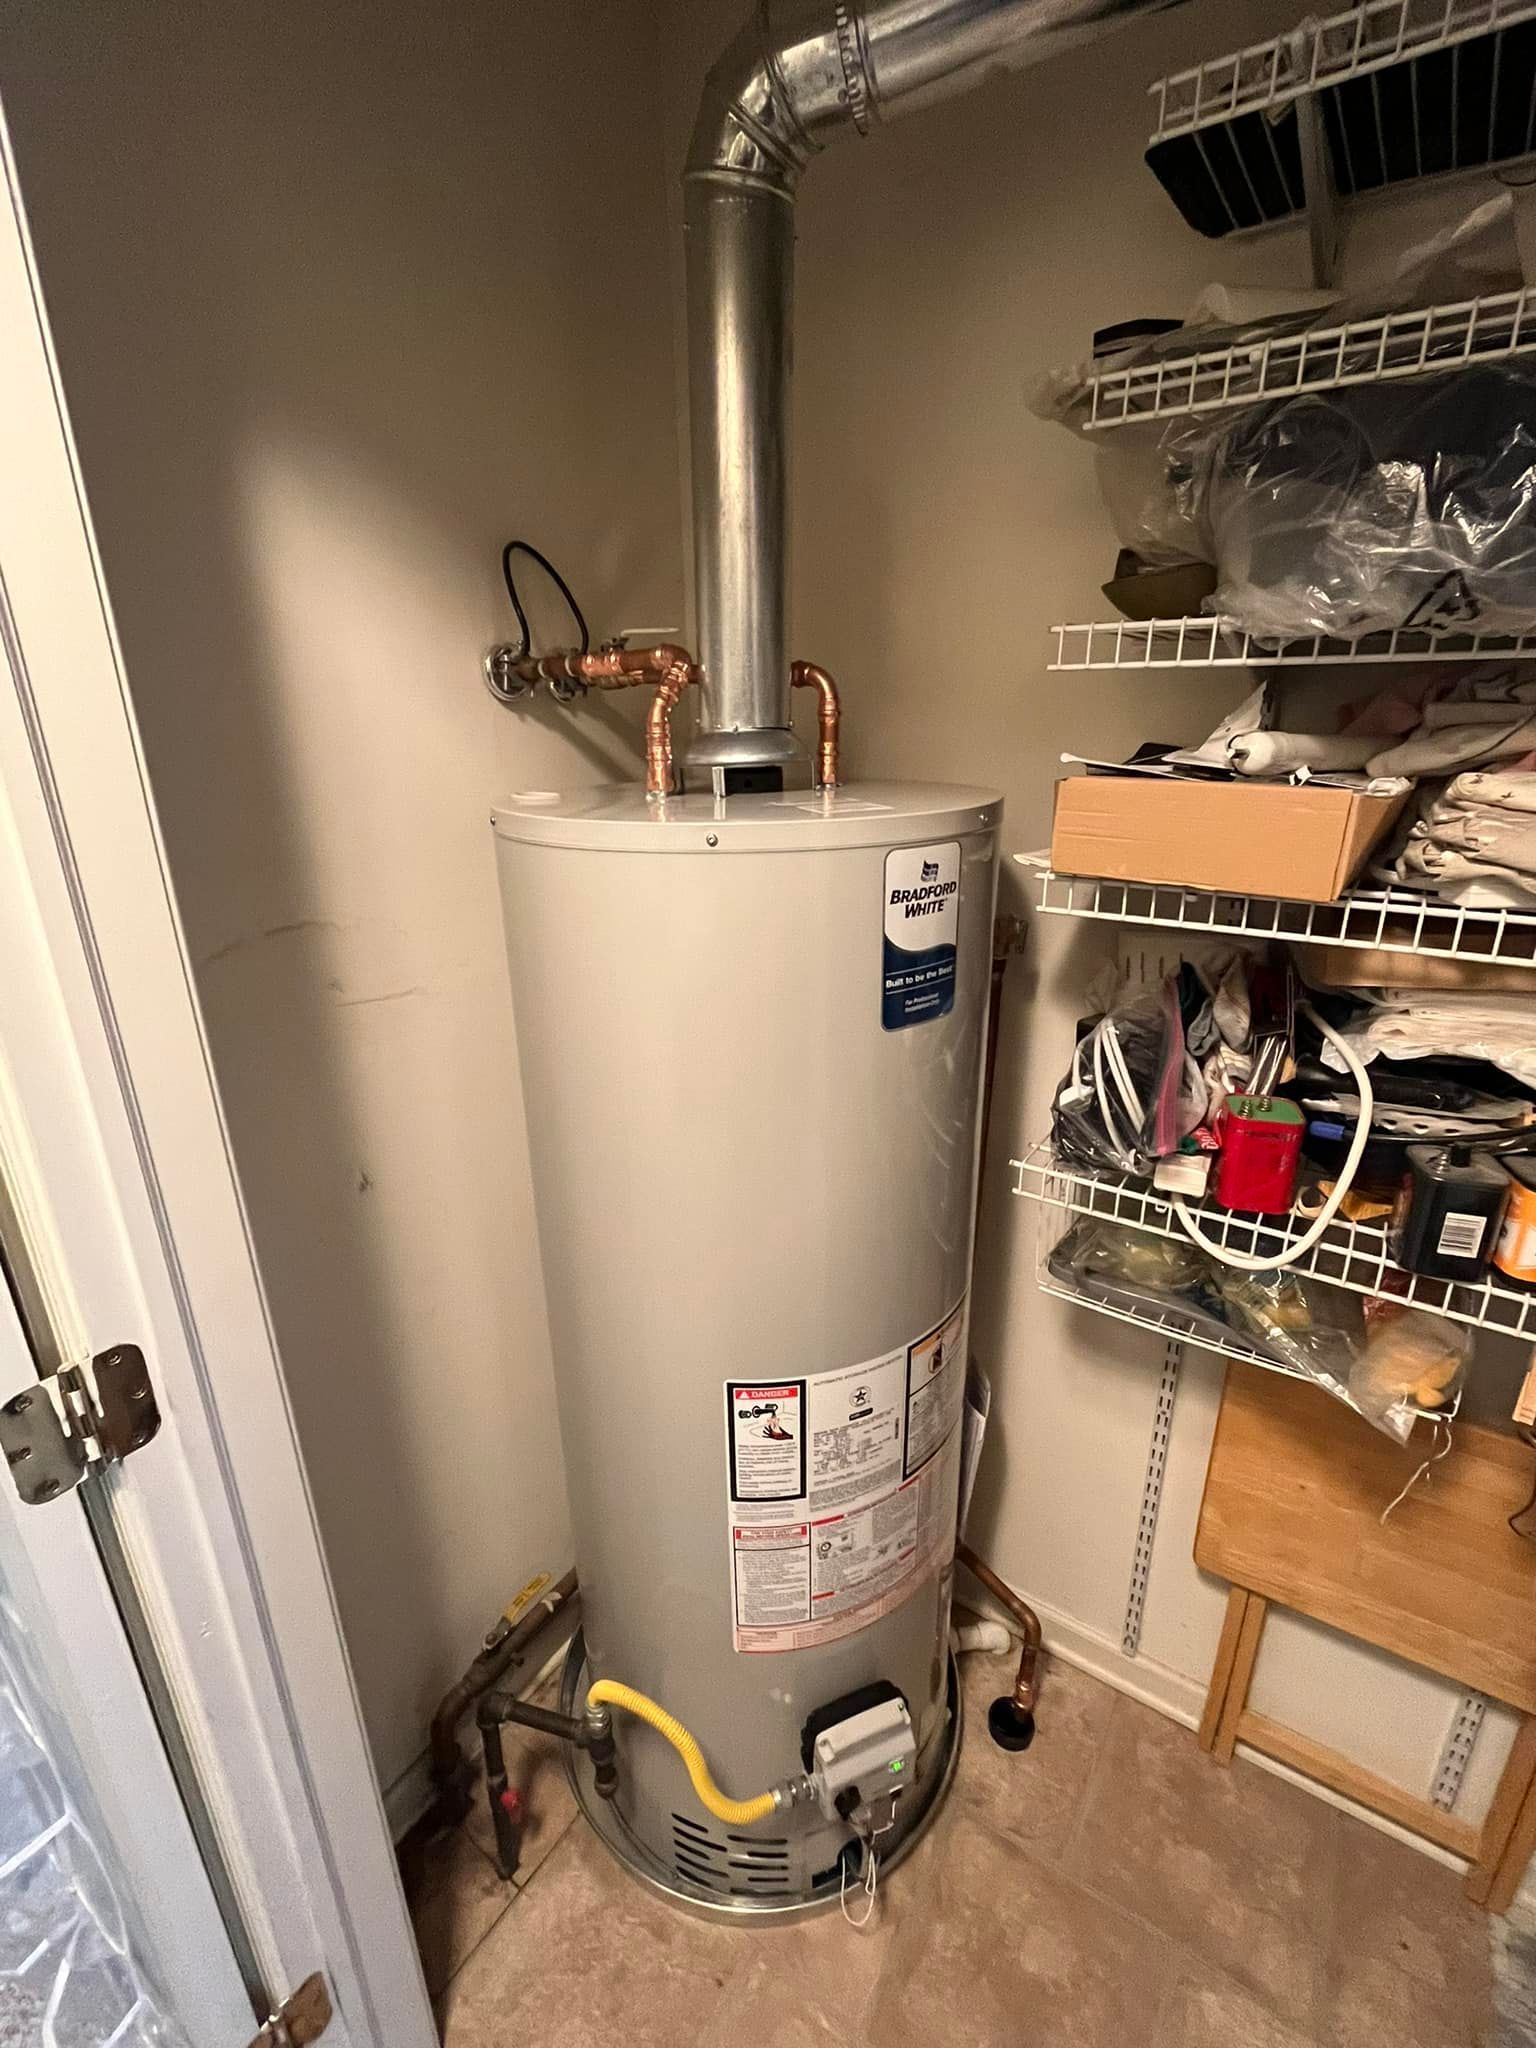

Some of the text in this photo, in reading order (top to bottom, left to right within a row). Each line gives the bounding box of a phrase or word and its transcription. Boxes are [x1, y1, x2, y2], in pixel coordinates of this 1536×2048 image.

[890, 881, 957, 905] BRADFORD
[905, 900, 945, 918] WHITE
[886, 978, 904, 989] Built
[905, 976, 914, 985] to
[915, 974, 925, 982] be
[752, 1390, 789, 1398] DANGER
